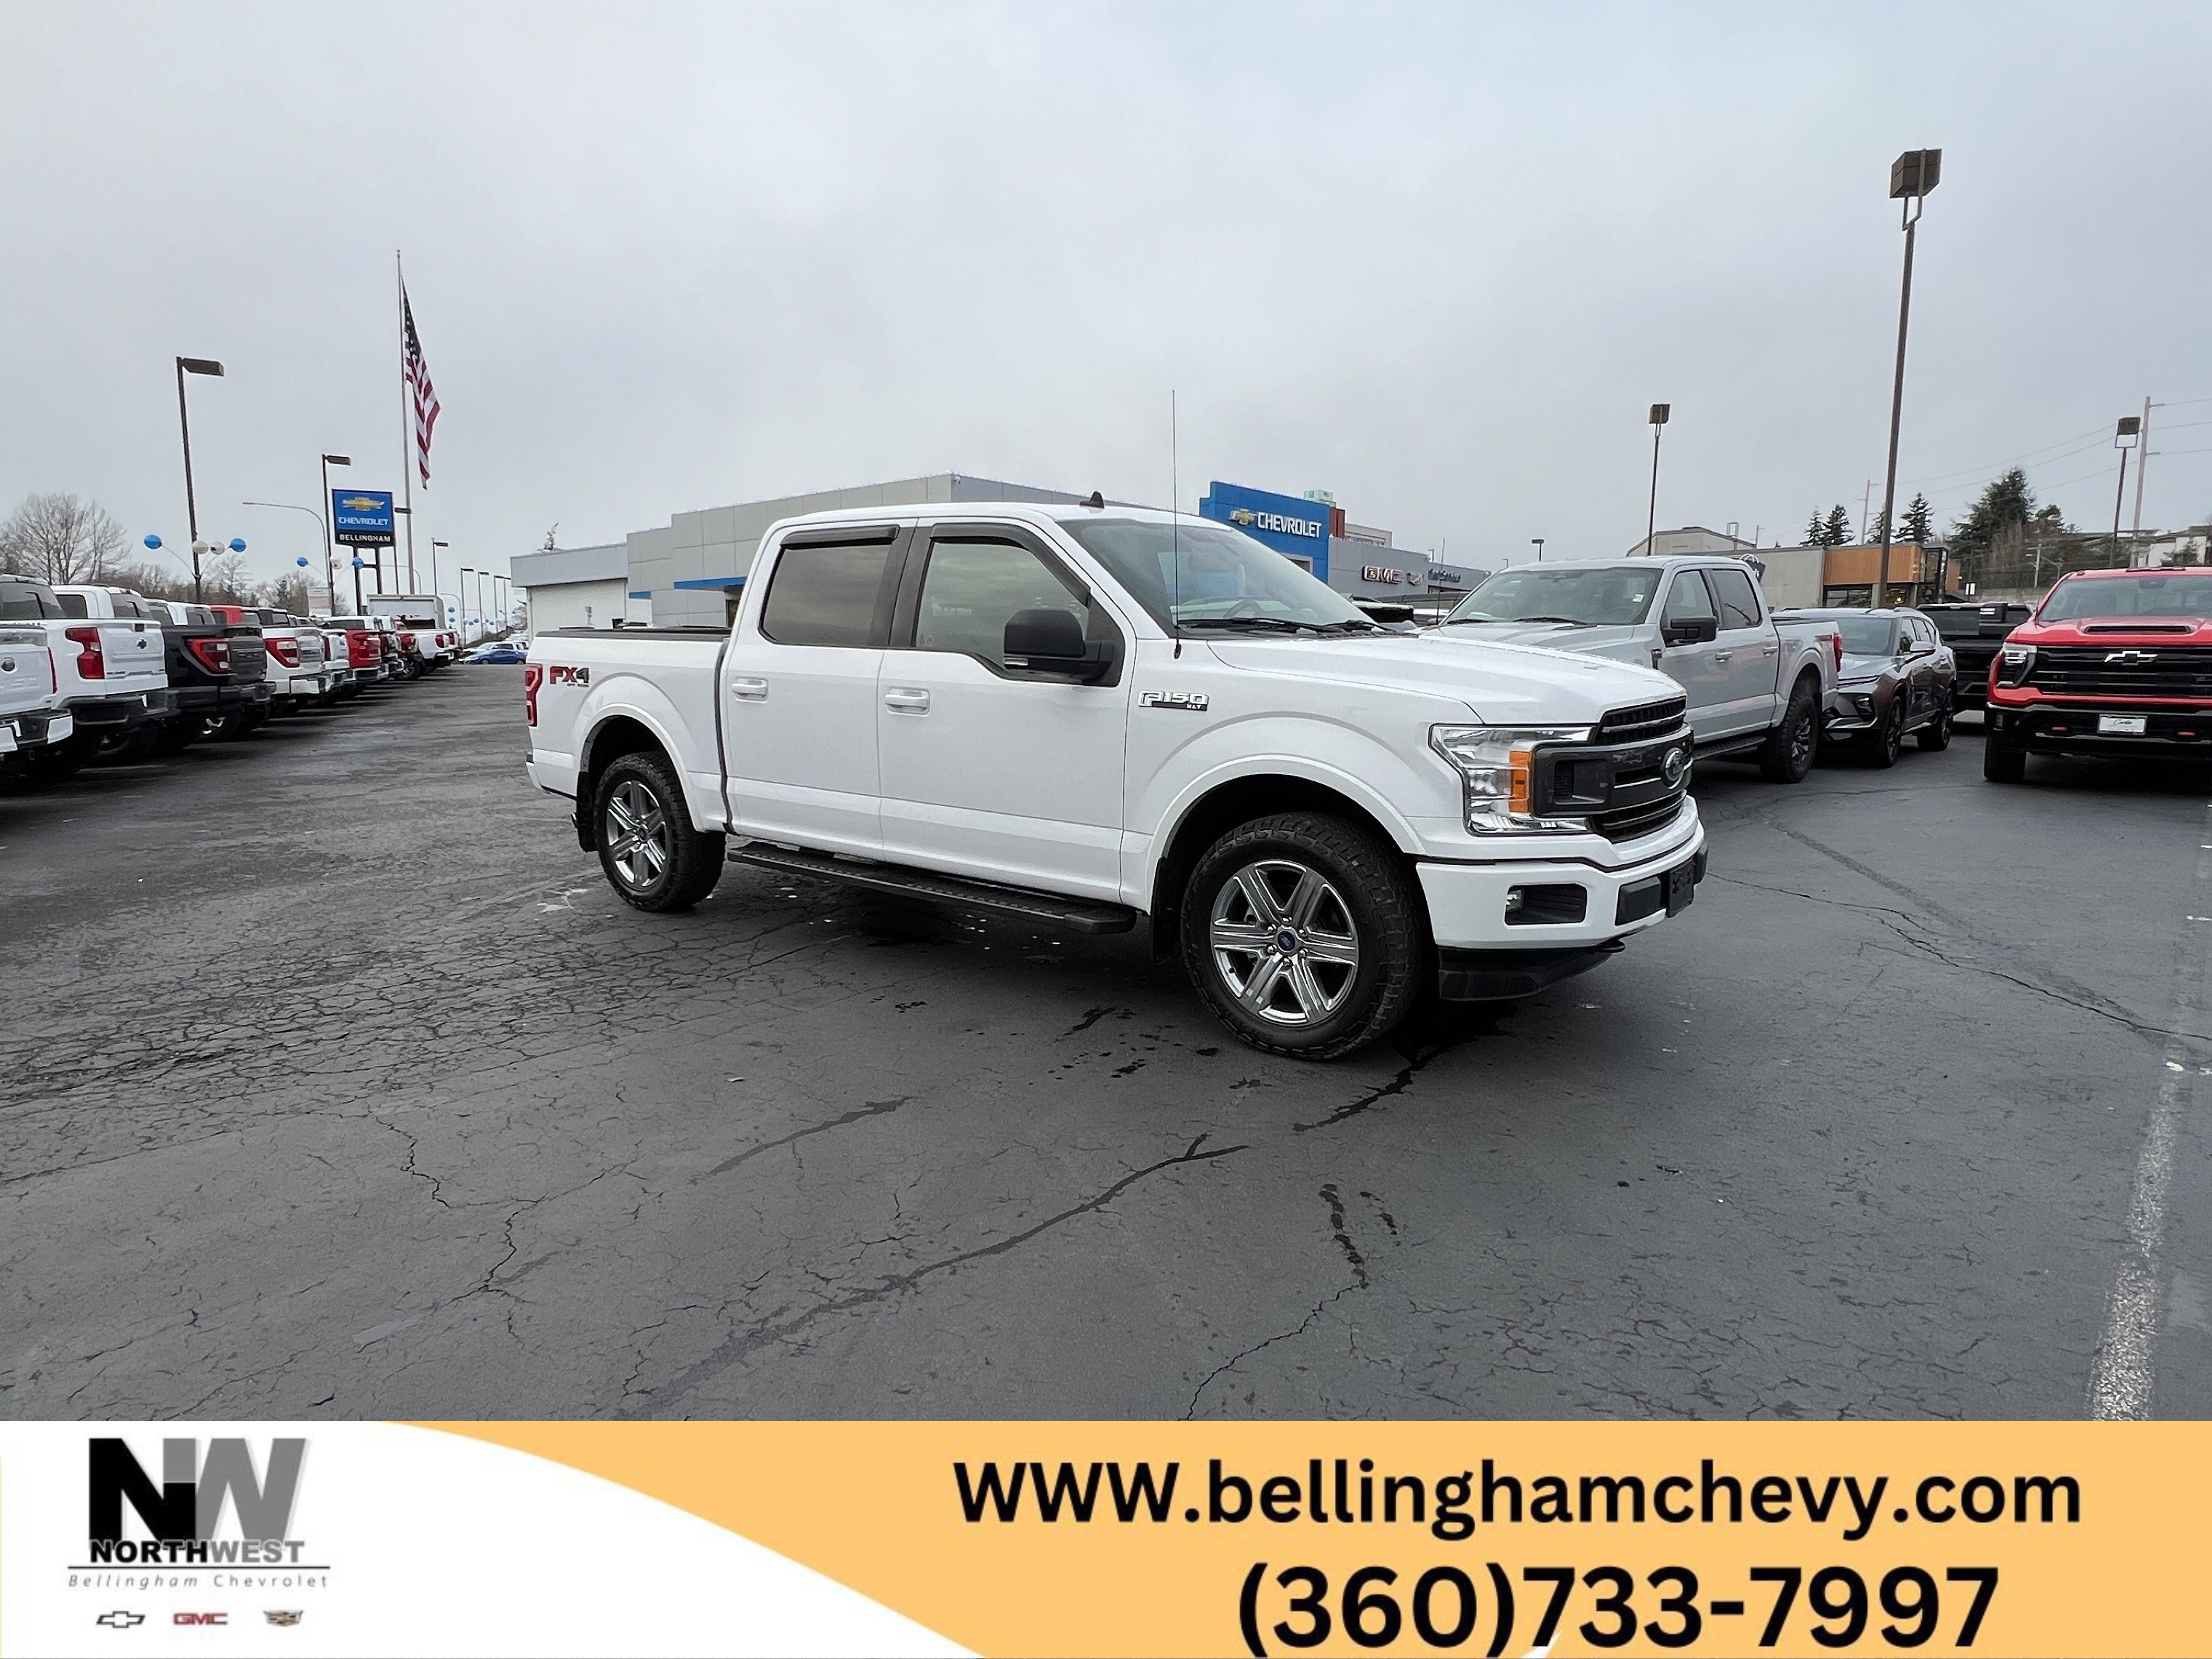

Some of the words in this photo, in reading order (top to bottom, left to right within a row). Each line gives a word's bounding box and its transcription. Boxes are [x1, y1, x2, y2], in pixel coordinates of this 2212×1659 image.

[338, 517, 388, 526] CHEVROLET
[1257, 511, 1322, 538] CHEVROLET
[339, 534, 391, 542] BELLINGHAM
[1363, 565, 1402, 585] GMC
[550, 667, 589, 684] FX4
